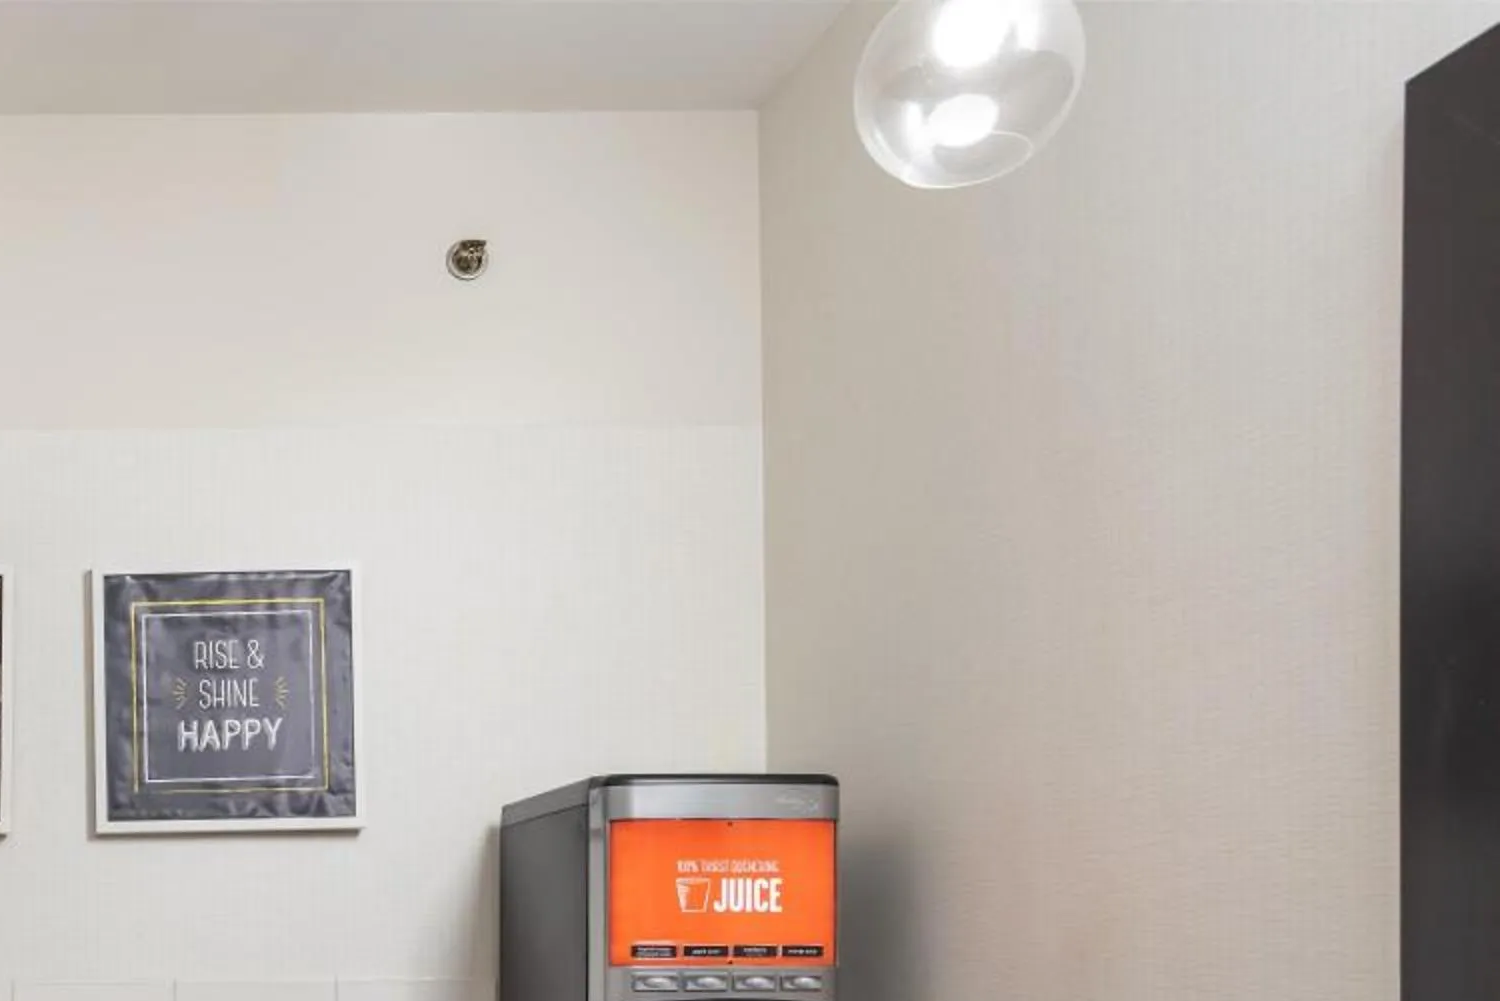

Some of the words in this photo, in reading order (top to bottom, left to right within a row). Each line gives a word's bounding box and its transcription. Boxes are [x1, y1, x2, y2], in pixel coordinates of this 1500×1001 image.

[194, 640, 241, 670] RISE
[247, 639, 265, 669] &
[198, 678, 261, 710] SHINE
[176, 717, 283, 752] HAPPY
[713, 878, 783, 913] JUICE
